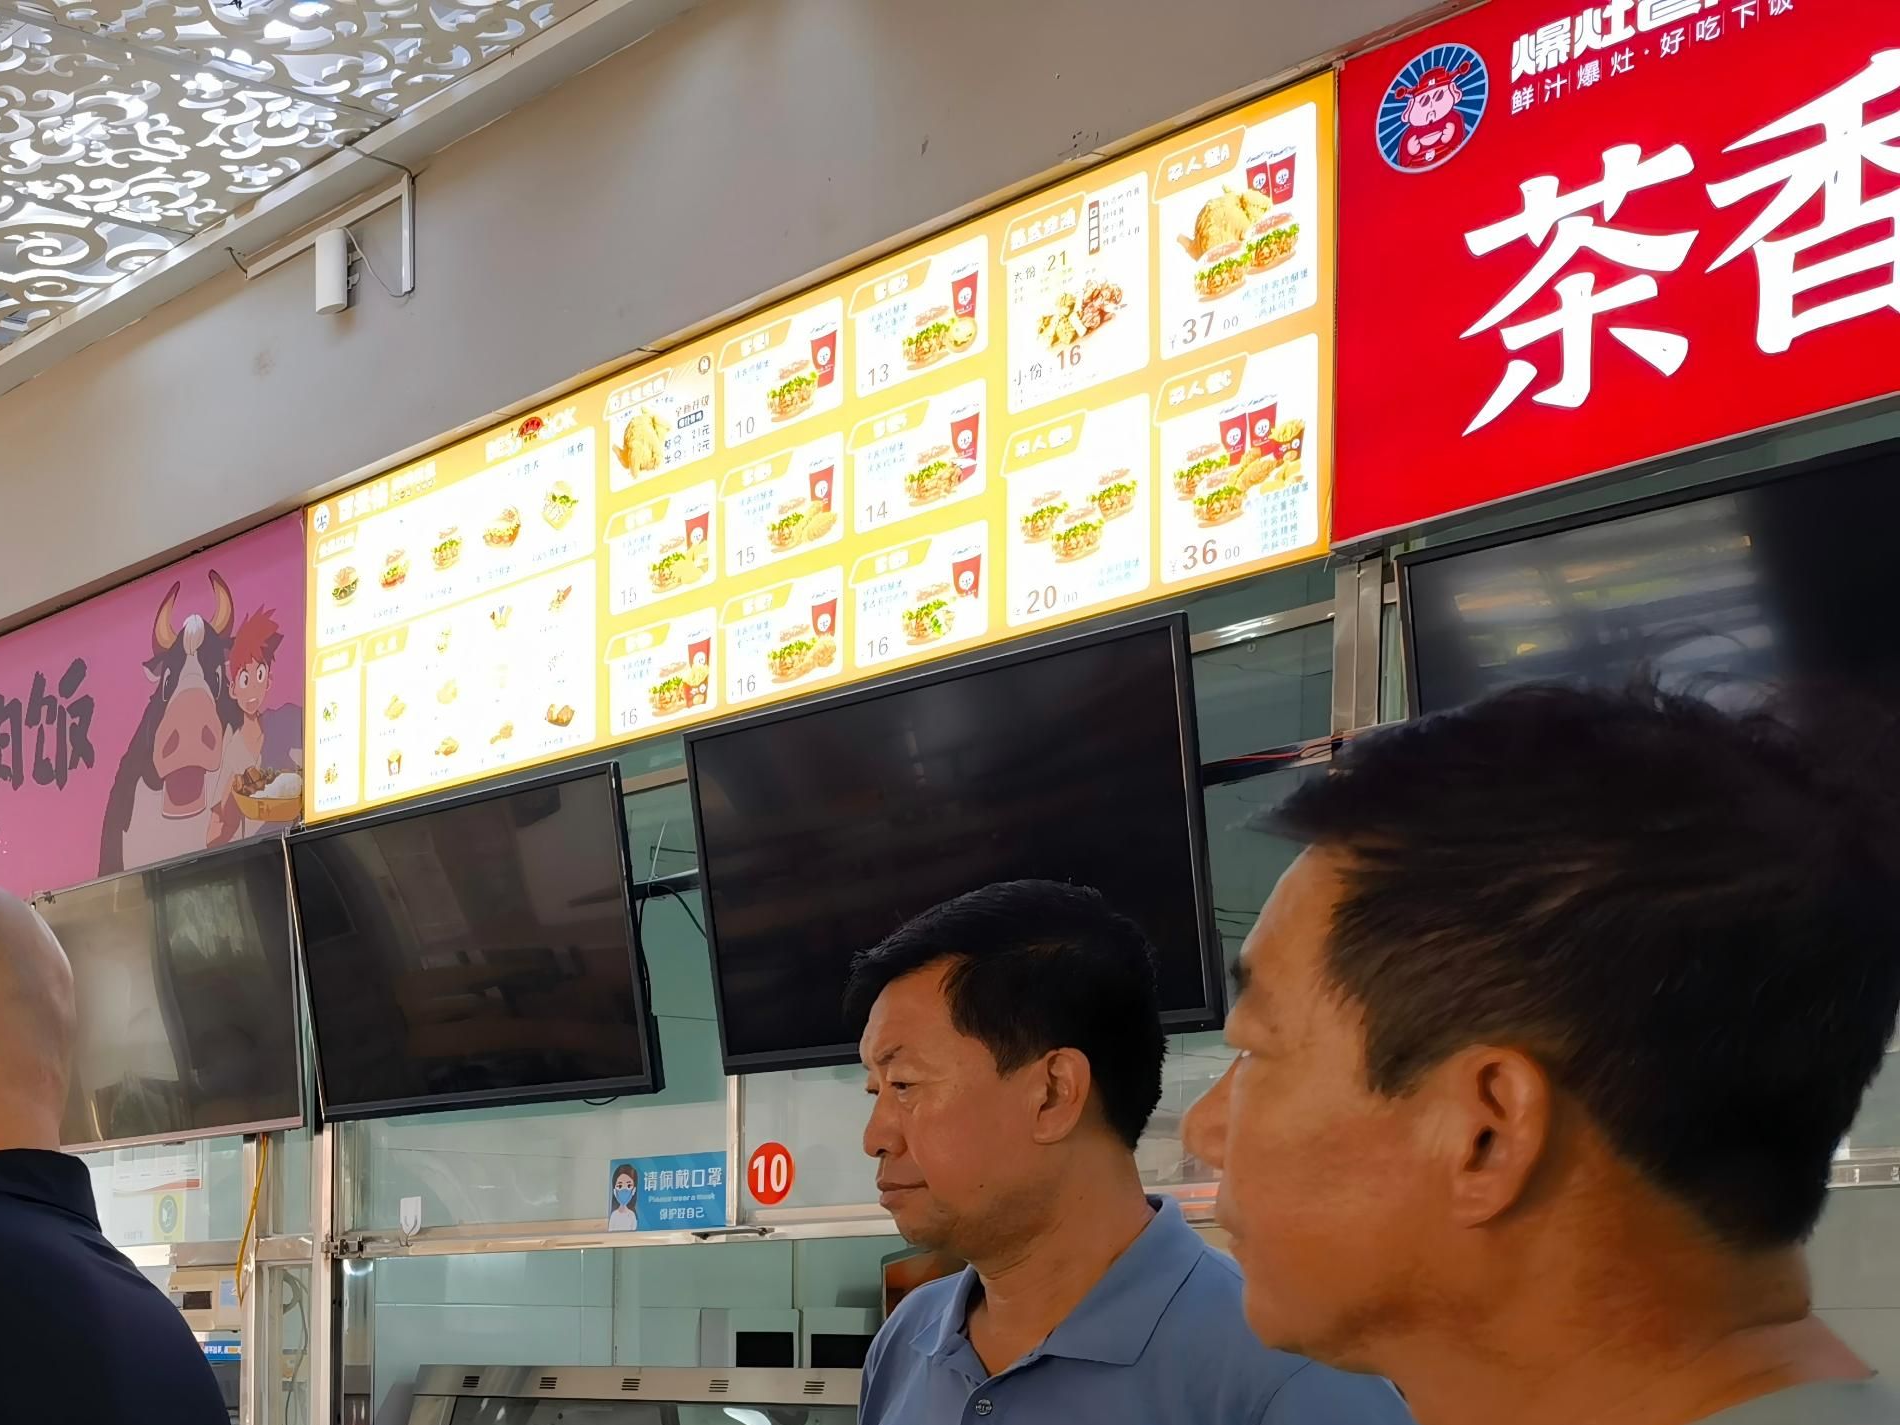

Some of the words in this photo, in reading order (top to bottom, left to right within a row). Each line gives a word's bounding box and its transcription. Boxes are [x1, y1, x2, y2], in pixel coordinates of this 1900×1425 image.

[1459, 47, 1900, 437] 茶香
[1182, 311, 1215, 345] 37
[1057, 345, 1082, 371] 16
[868, 363, 890, 386] 13
[735, 416, 755, 438] 10
[866, 501, 888, 523] 14
[736, 547, 756, 566] 15
[1182, 539, 1218, 571] 36
[1027, 585, 1057, 615] 20
[867, 636, 890, 658] 16
[736, 674, 756, 694] 16
[620, 708, 638, 727] 16
[643, 1167, 722, 1191] 请佩戴口罩
[753, 1154, 788, 1193] 10
